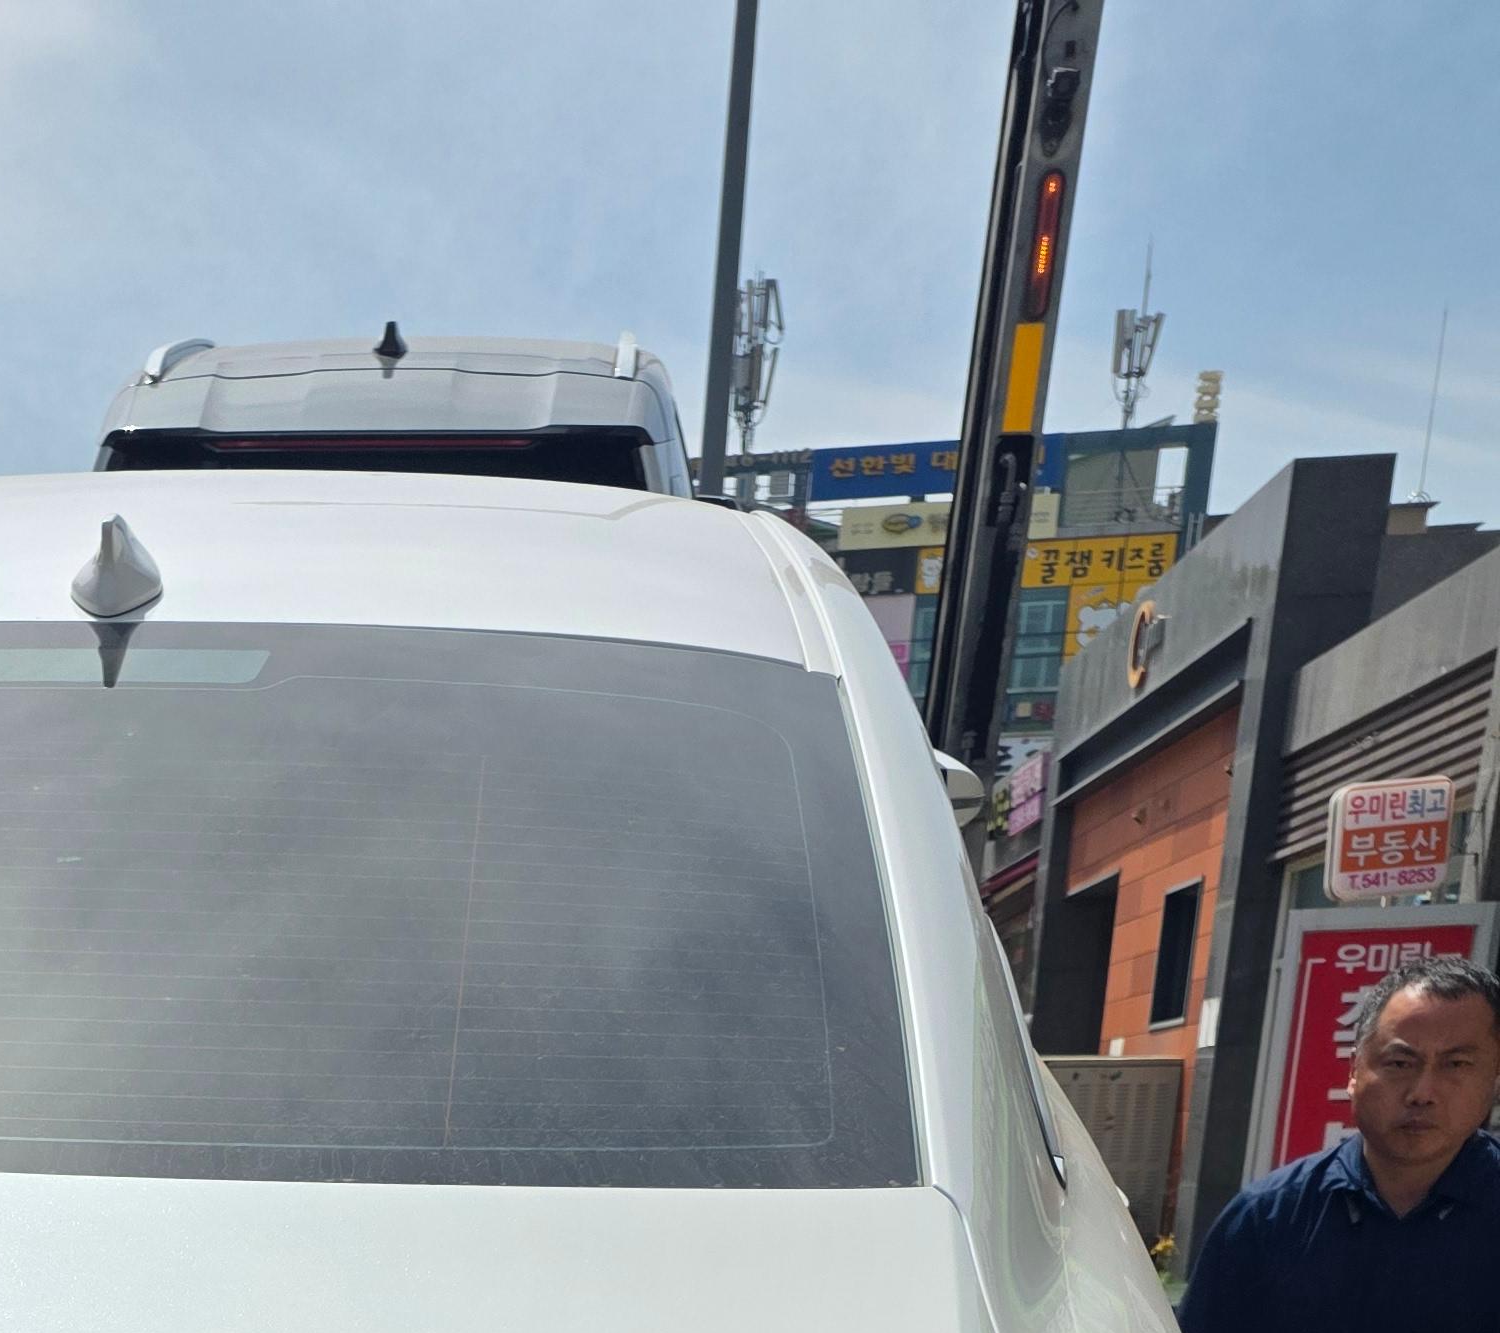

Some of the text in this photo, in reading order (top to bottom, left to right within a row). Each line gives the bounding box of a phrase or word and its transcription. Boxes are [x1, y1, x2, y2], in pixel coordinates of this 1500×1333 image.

[1040, 542, 1167, 585] 꿀잼 키즈룸
[1348, 787, 1446, 824] 우미린최고
[1347, 827, 1441, 867] 부동산
